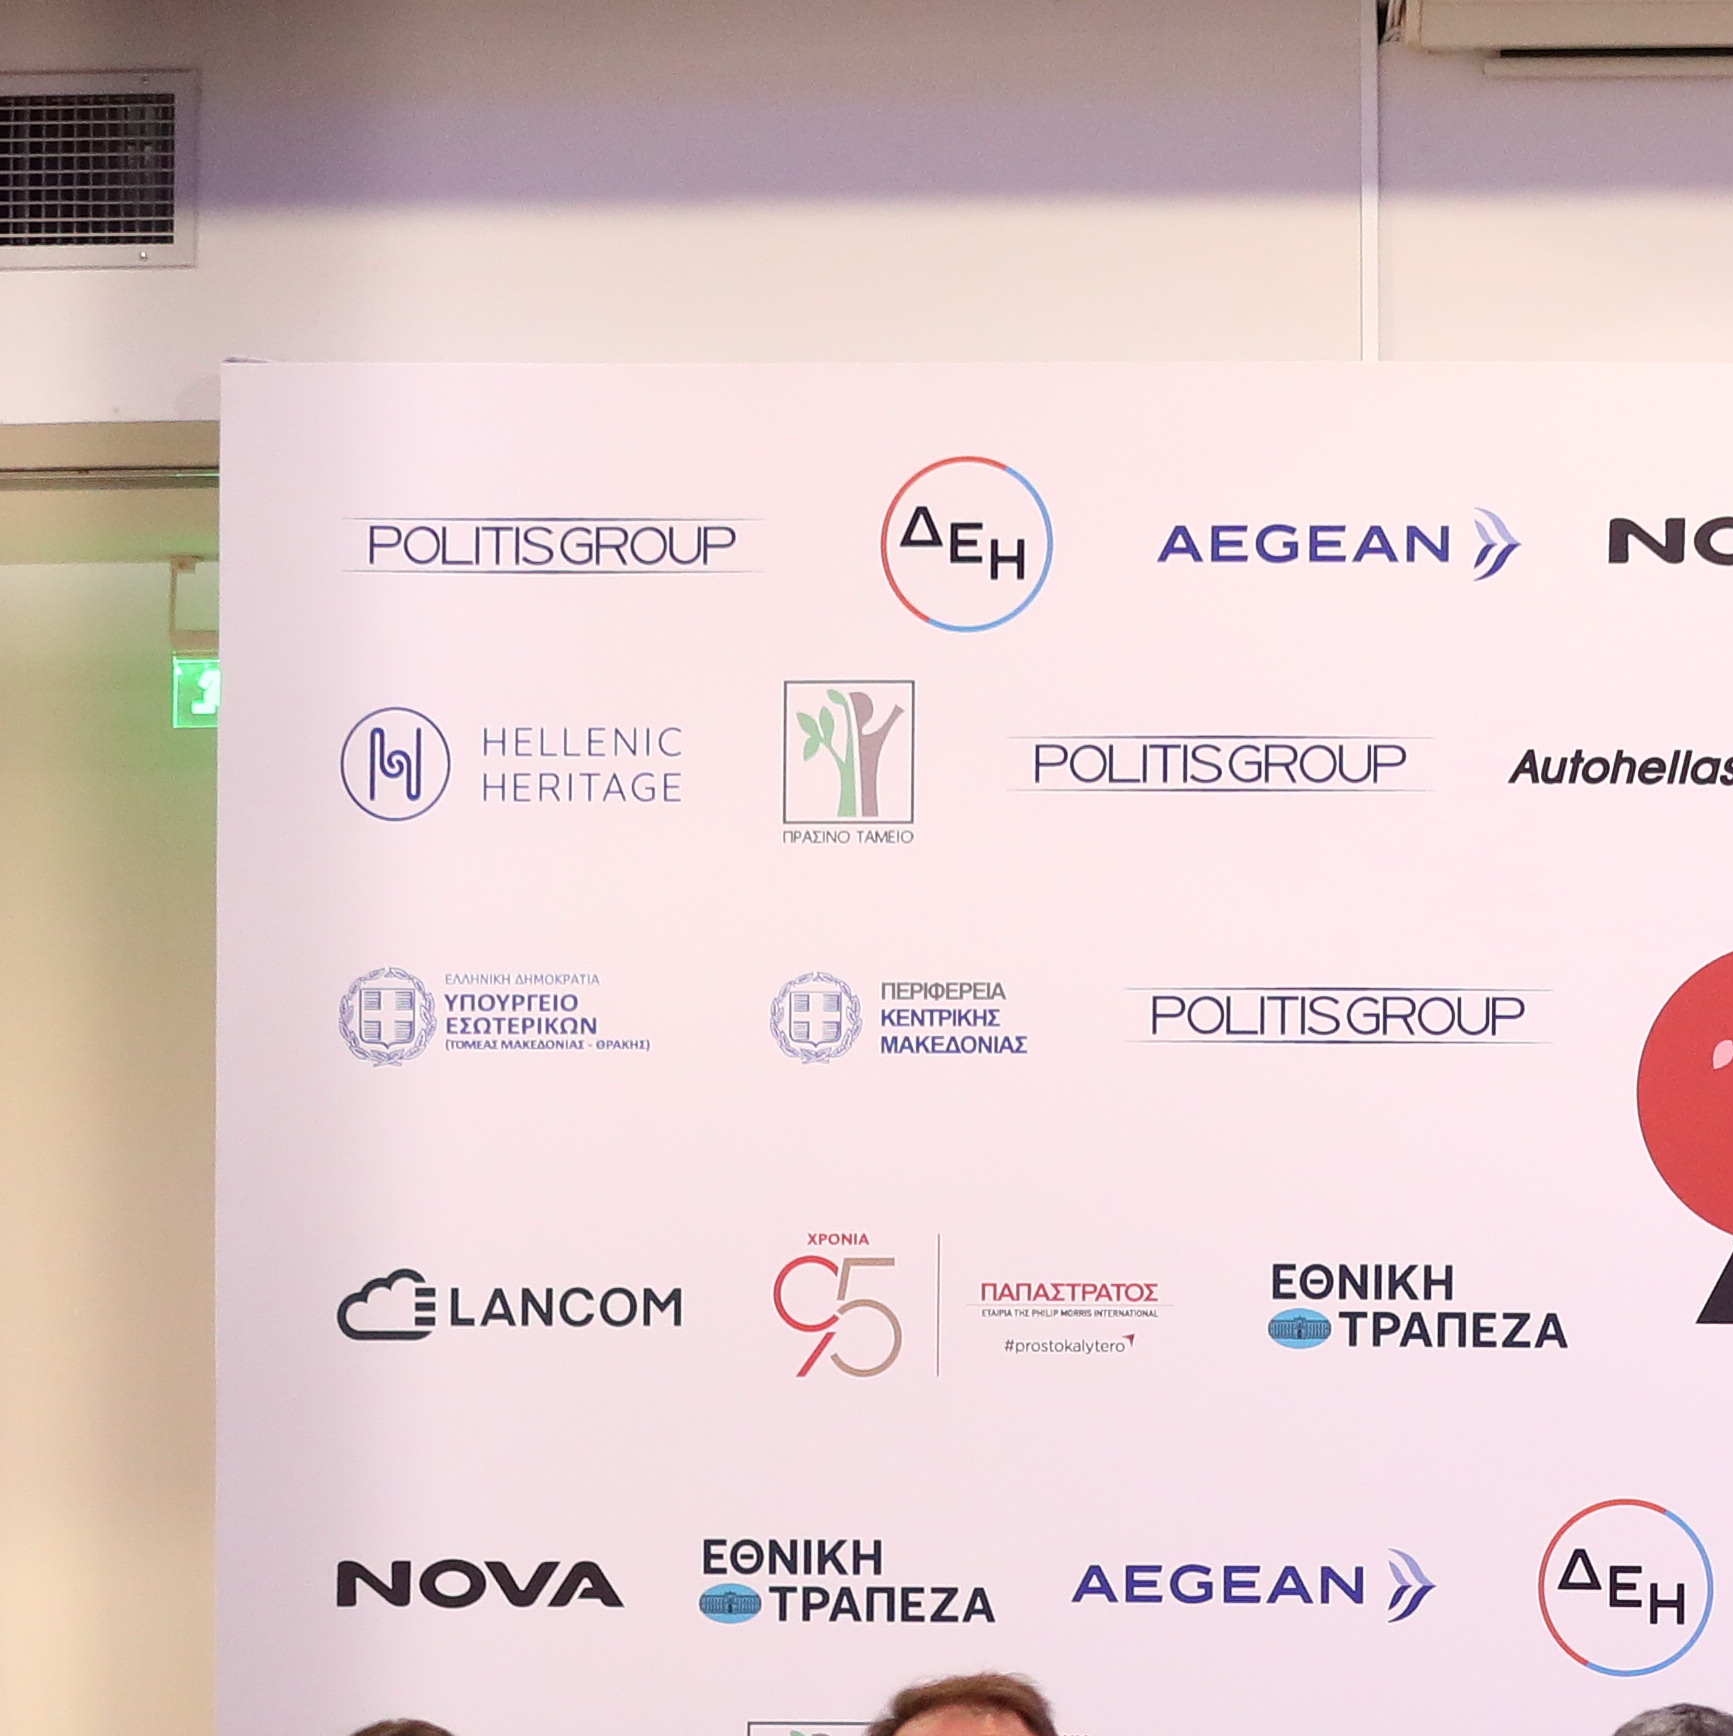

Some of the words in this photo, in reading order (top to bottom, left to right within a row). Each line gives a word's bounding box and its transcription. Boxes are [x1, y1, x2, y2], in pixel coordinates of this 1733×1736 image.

[369, 525, 737, 566] POLITISGROUP
[899, 505, 1025, 581] ΔΕΗ
[1157, 523, 1450, 564] AEGEAN
[483, 727, 682, 757] HELLENIC
[1034, 743, 1407, 784] POLITISGROUP
[483, 772, 681, 803] HERITAGE
[782, 829, 851, 844] ΠΡΑΣΙΝΟ
[856, 829, 915, 844] ΤΑΜΕΙΟ
[445, 973, 511, 985] ΕΛΛΗΝΙΚΗ
[515, 973, 600, 986] ΔΗΜΟΚΡΑΤΙΑ
[881, 981, 1007, 1001] ΠΕΡΙΦΕΡΕΙΑ
[444, 993, 579, 1012] ΥΠΟΥΡΓΕΙΟ
[881, 1008, 1001, 1027] ΚΕΝΤΡΙΚΗΣ
[1152, 995, 1526, 1036] POLITISGROUP
[446, 1016, 597, 1035] ΕΣΩΤΕΡΙΚΩΝ
[880, 1035, 1028, 1054] ΜΑΚΕΔΟΝΙΑΣ
[445, 1039, 498, 1051] (ΤΟΜΕΑΣ
[500, 1039, 584, 1050] ΜΑΚΕΔΟΝΙΑΣ
[595, 1039, 651, 1052] ΘΡΑΚΗΣ)
[807, 1233, 870, 1246] ΧΡΟΝΙΑ
[981, 1282, 1159, 1303] ΠΑΠΑΣΤΡΑΤΟΣ
[1272, 1263, 1453, 1301] ΕΘΝΙΚΗ
[450, 1286, 682, 1328] LANCOM
[772, 1254, 902, 1378] 95
[1003, 1335, 1127, 1356] #prostokalytero
[1338, 1311, 1568, 1349] ΤΡΑΠΕΖΑ
[703, 1538, 882, 1576] ΕΘΝΙΚΗ
[336, 1558, 625, 1609] NOVA
[1071, 1563, 1364, 1605] AEGEAN
[1556, 1547, 1685, 1625] ΔΕΗ
[768, 1585, 996, 1623] ΤΡΑΠΕΖΑ
